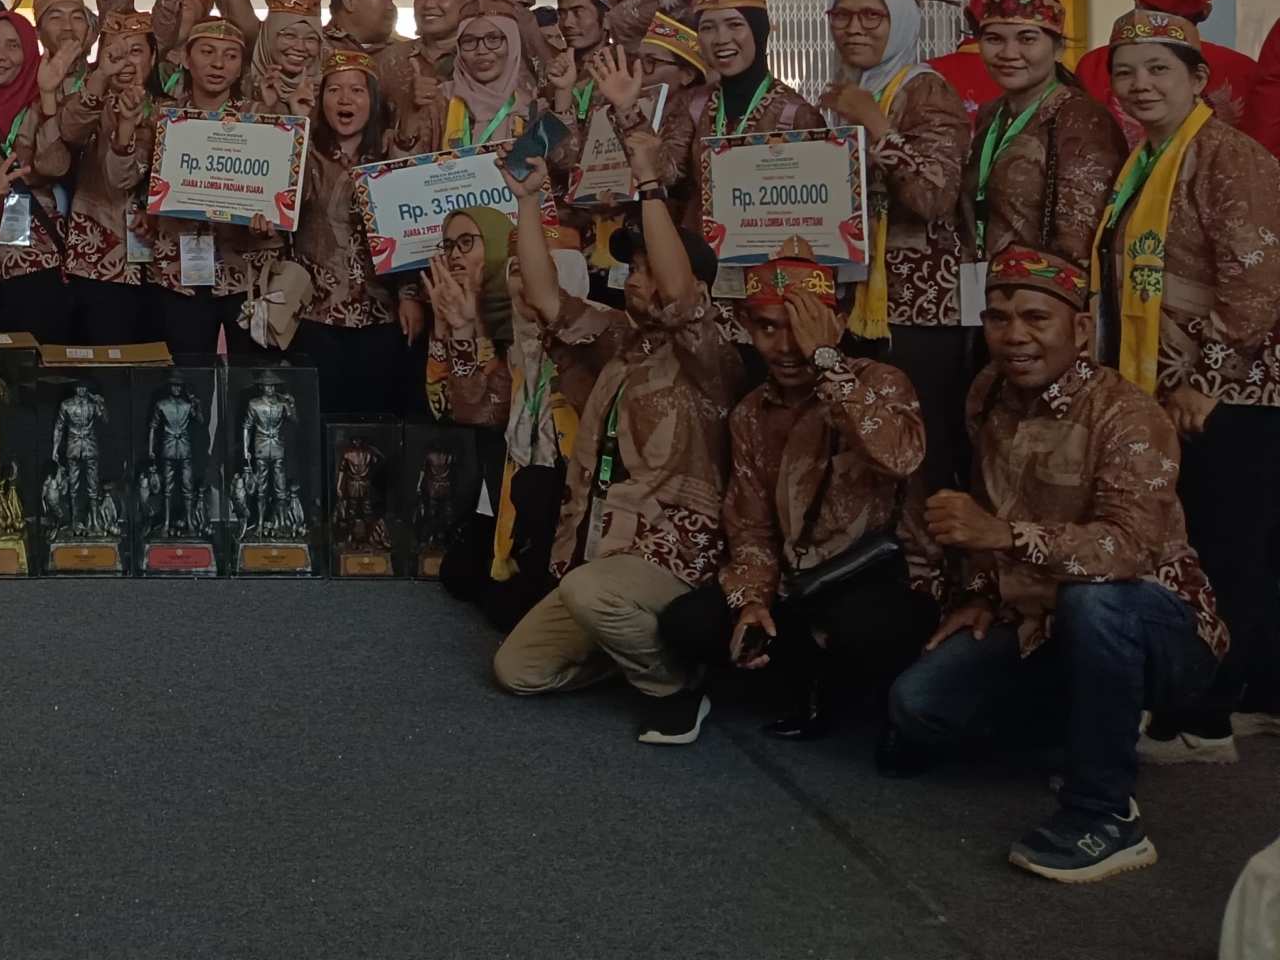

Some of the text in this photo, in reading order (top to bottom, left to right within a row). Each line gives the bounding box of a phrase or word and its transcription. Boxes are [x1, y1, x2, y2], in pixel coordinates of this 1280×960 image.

[180, 153, 269, 177] Rp. 3.500.000
[181, 179, 198, 188] JUARA
[204, 181, 221, 190] LOMBA
[223, 183, 244, 192] PADUAN
[246, 185, 264, 194] SUARA
[398, 186, 512, 223] Rp. 3.500.000
[732, 183, 828, 213] Rp. 2.000.000
[402, 226, 421, 238] JUARA
[427, 224, 444, 235] PERT
[740, 218, 758, 228] JUARA
[764, 218, 784, 227] LOMBA
[785, 217, 800, 227] VLOG
[802, 217, 823, 226] PETANI
